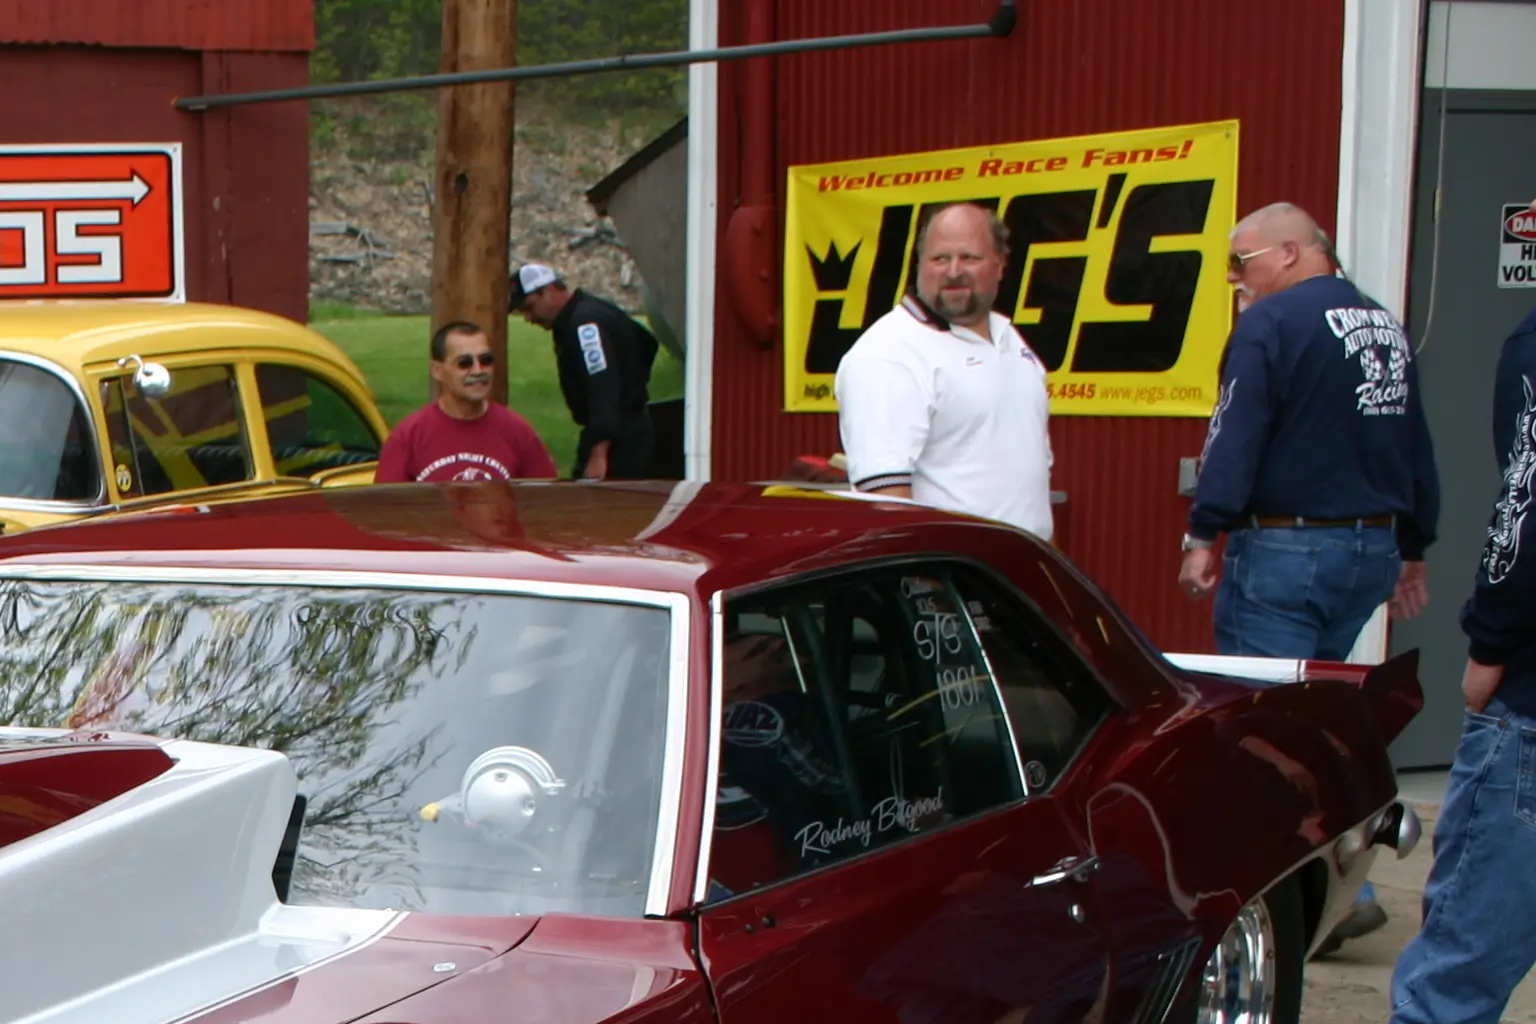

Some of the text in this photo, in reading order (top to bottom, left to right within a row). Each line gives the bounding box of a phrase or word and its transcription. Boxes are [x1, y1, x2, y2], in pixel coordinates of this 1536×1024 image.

[818, 139, 1195, 193] Welcome Race Fans!
[1511, 216, 1536, 233] DA
[1502, 264, 1536, 282] VOL
[1099, 384, 1203, 405] www.jegs.com
[794, 816, 872, 858] Rodney
